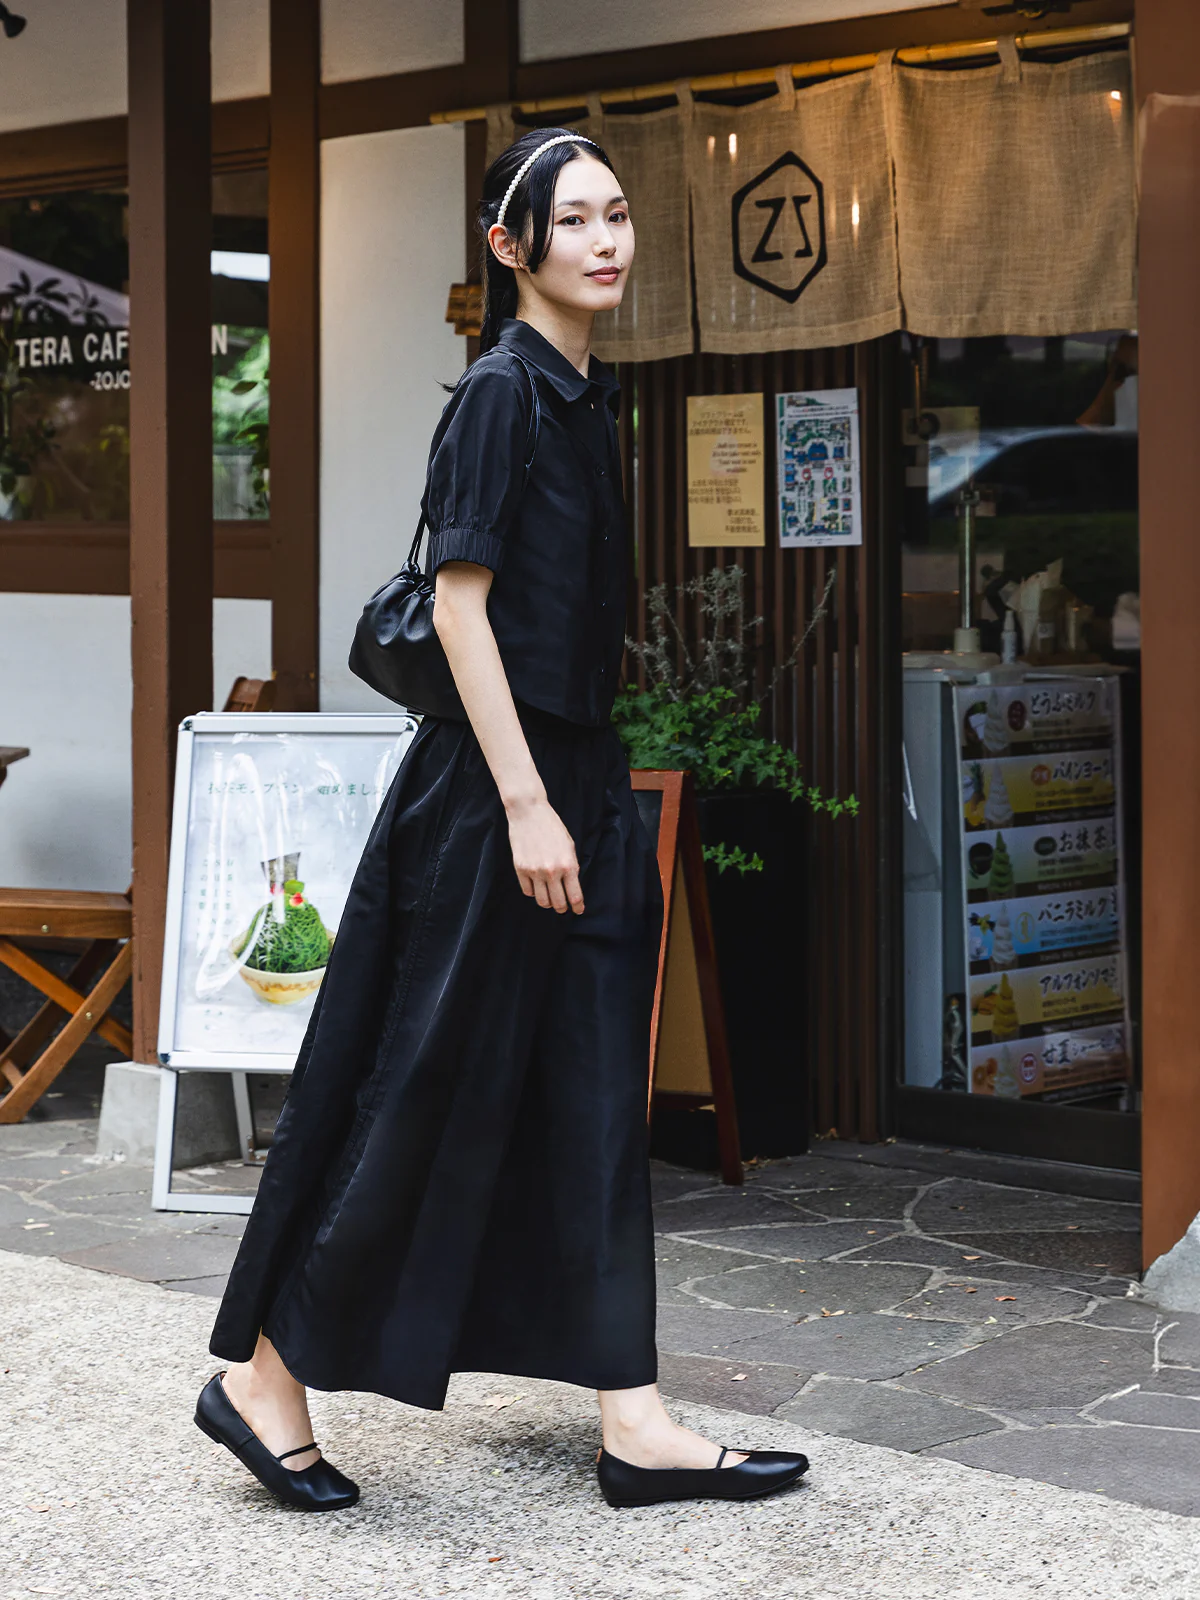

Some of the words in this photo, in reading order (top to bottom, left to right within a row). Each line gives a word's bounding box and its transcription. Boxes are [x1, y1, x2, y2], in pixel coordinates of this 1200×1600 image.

[15, 335, 73, 367] TERA
[83, 331, 130, 363] CAF
[89, 369, 132, 391] -ZOJO
